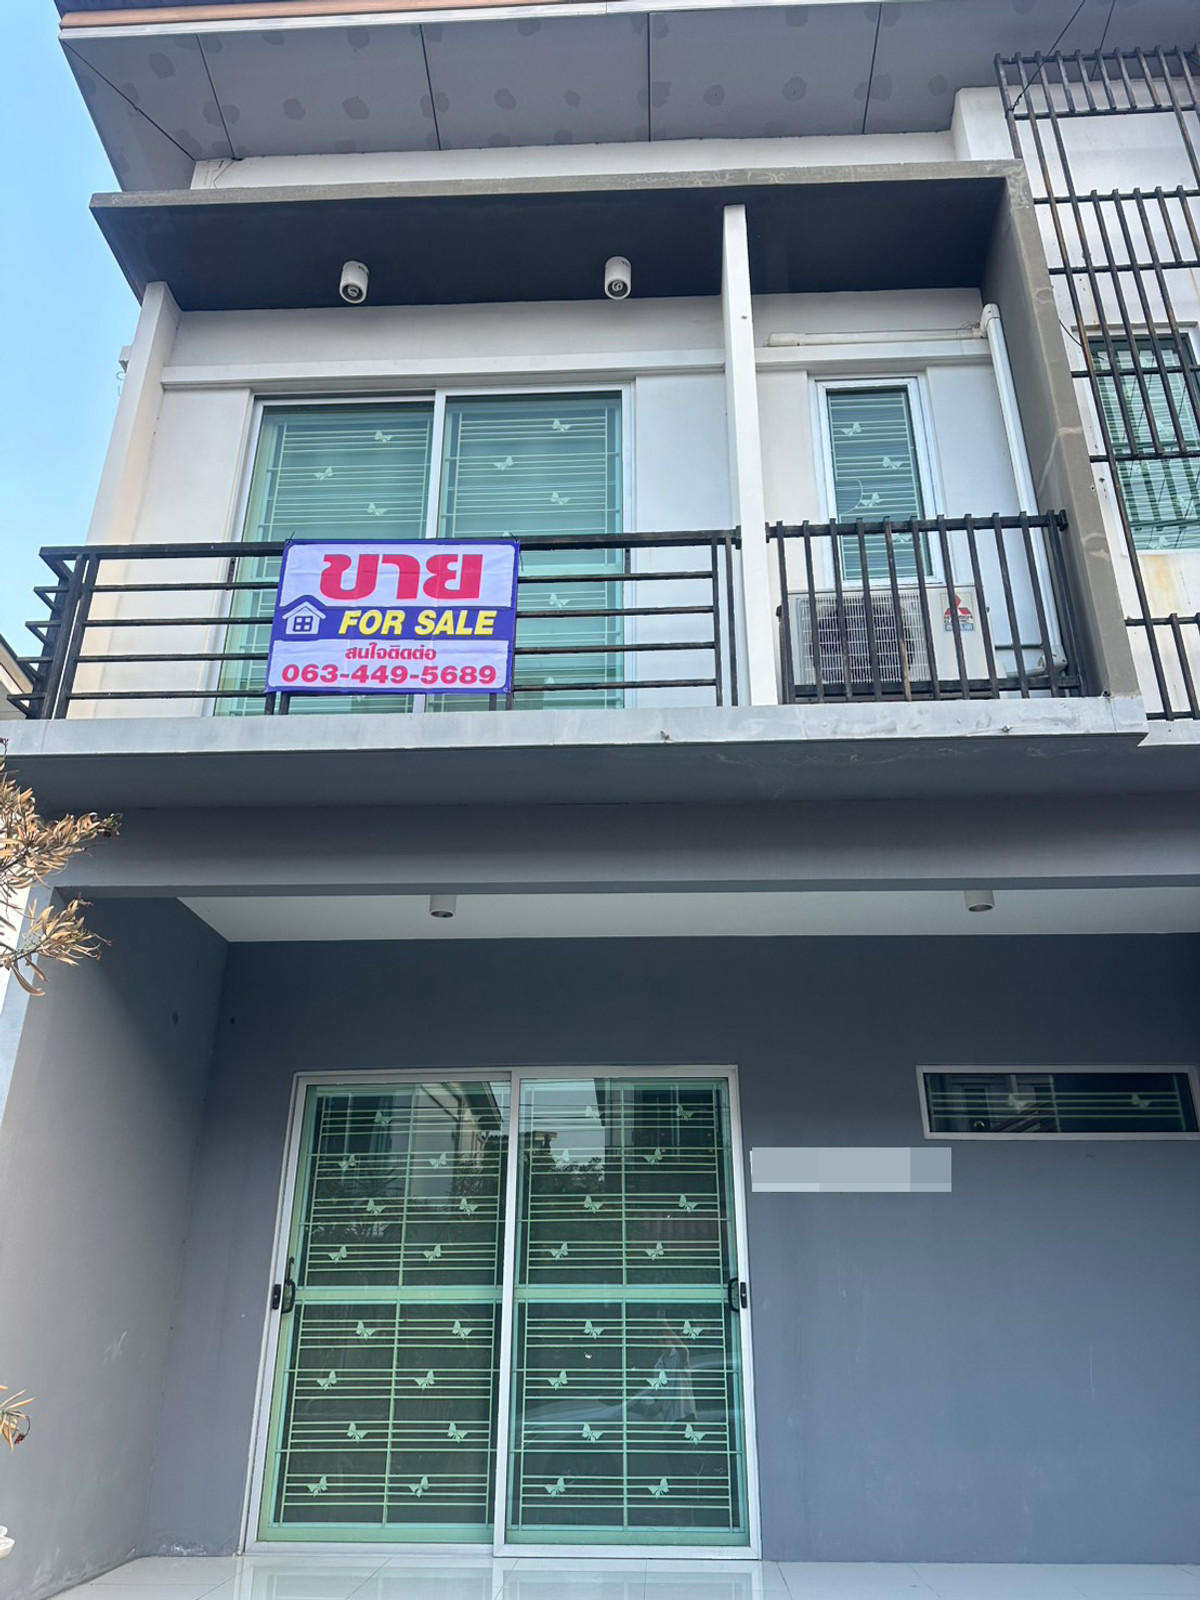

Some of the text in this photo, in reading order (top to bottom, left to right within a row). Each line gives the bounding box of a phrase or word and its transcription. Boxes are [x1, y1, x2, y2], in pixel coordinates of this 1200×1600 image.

[319, 553, 484, 600] ขาย
[338, 609, 498, 636] FOR SALE
[345, 642, 437, 661] สนใจติดต่อ
[281, 664, 497, 685] 063-449-5689
